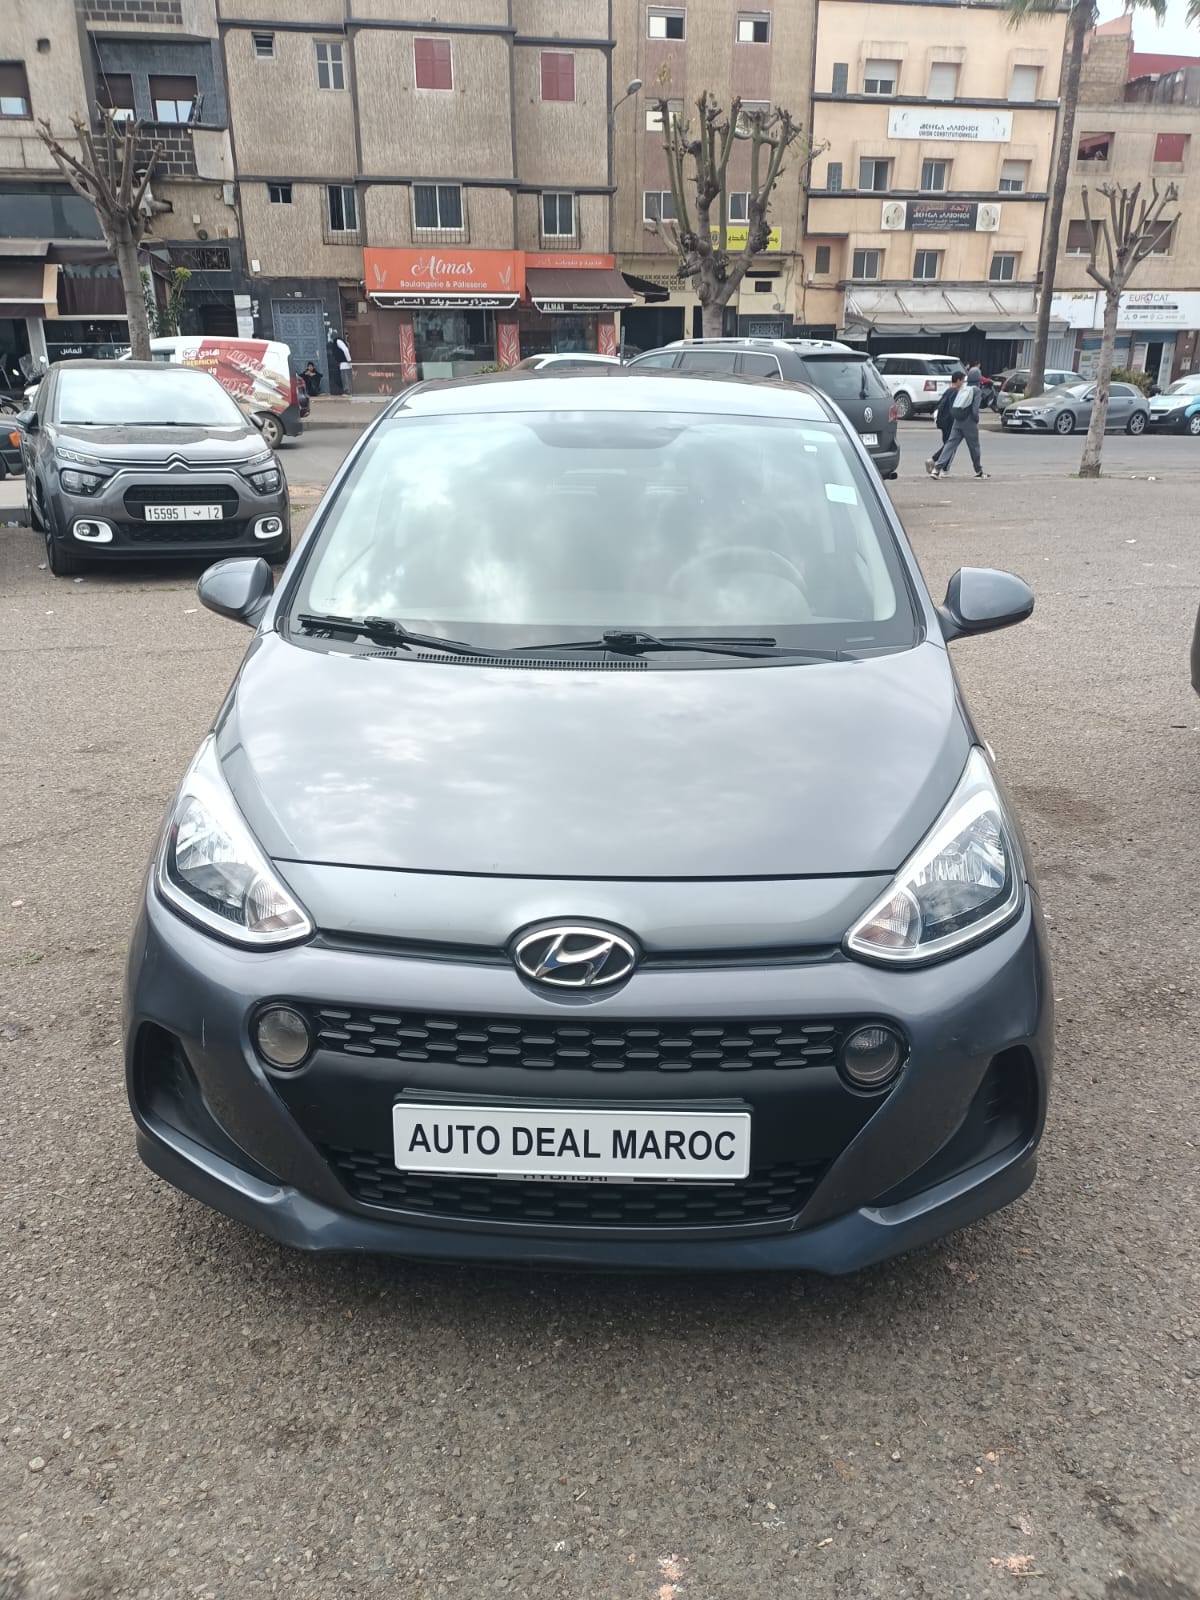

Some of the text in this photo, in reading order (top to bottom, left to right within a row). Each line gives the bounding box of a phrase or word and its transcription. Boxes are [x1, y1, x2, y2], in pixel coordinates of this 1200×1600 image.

[410, 255, 475, 279] Almas
[400, 279, 444, 289] Boulangerie
[445, 280, 450, 288] &
[149, 507, 179, 520] 15595
[213, 507, 220, 519] 2
[408, 1123, 737, 1162] AUTO DEAL MAROC
